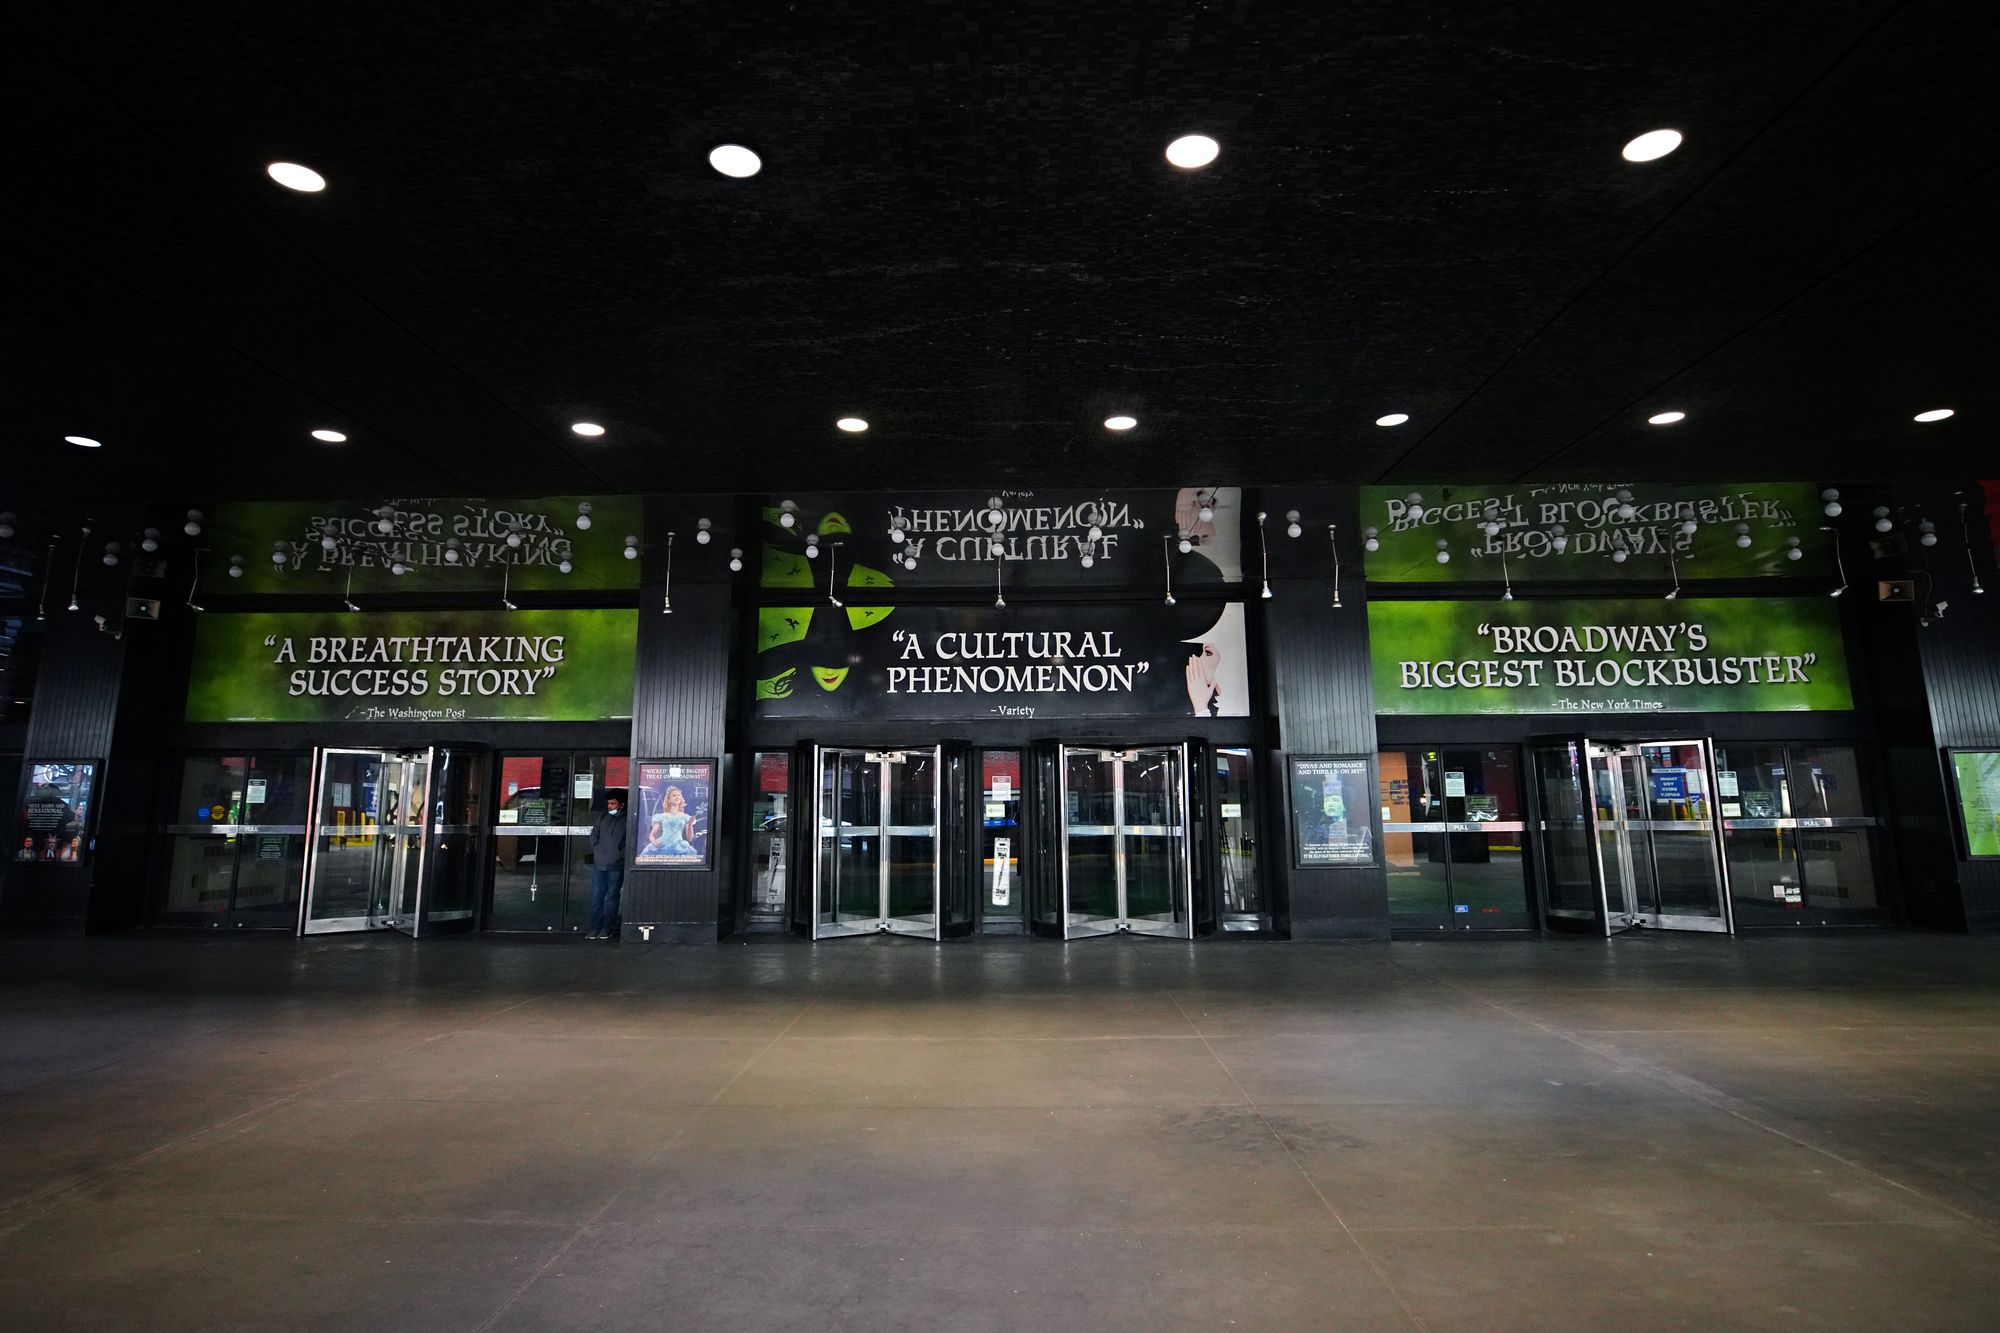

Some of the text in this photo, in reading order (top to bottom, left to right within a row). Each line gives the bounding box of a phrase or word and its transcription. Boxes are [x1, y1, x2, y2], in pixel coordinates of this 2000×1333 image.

[264, 634, 565, 664] “A BREATHTAKING
[892, 629, 1122, 660] “A CULTURAL
[1477, 622, 1708, 654] “BROADWAY’S
[288, 665, 556, 697] SUCCESS STORY”
[886, 661, 1150, 694] PHENOMENON”
[1399, 653, 1817, 689] BIGGEST BLOCKBUSTER”
[388, 707, 444, 720] Washington
[446, 707, 466, 719] Post
[1581, 699, 1603, 710] New
[1604, 699, 1631, 710] York
[1634, 699, 1664, 710] Times
